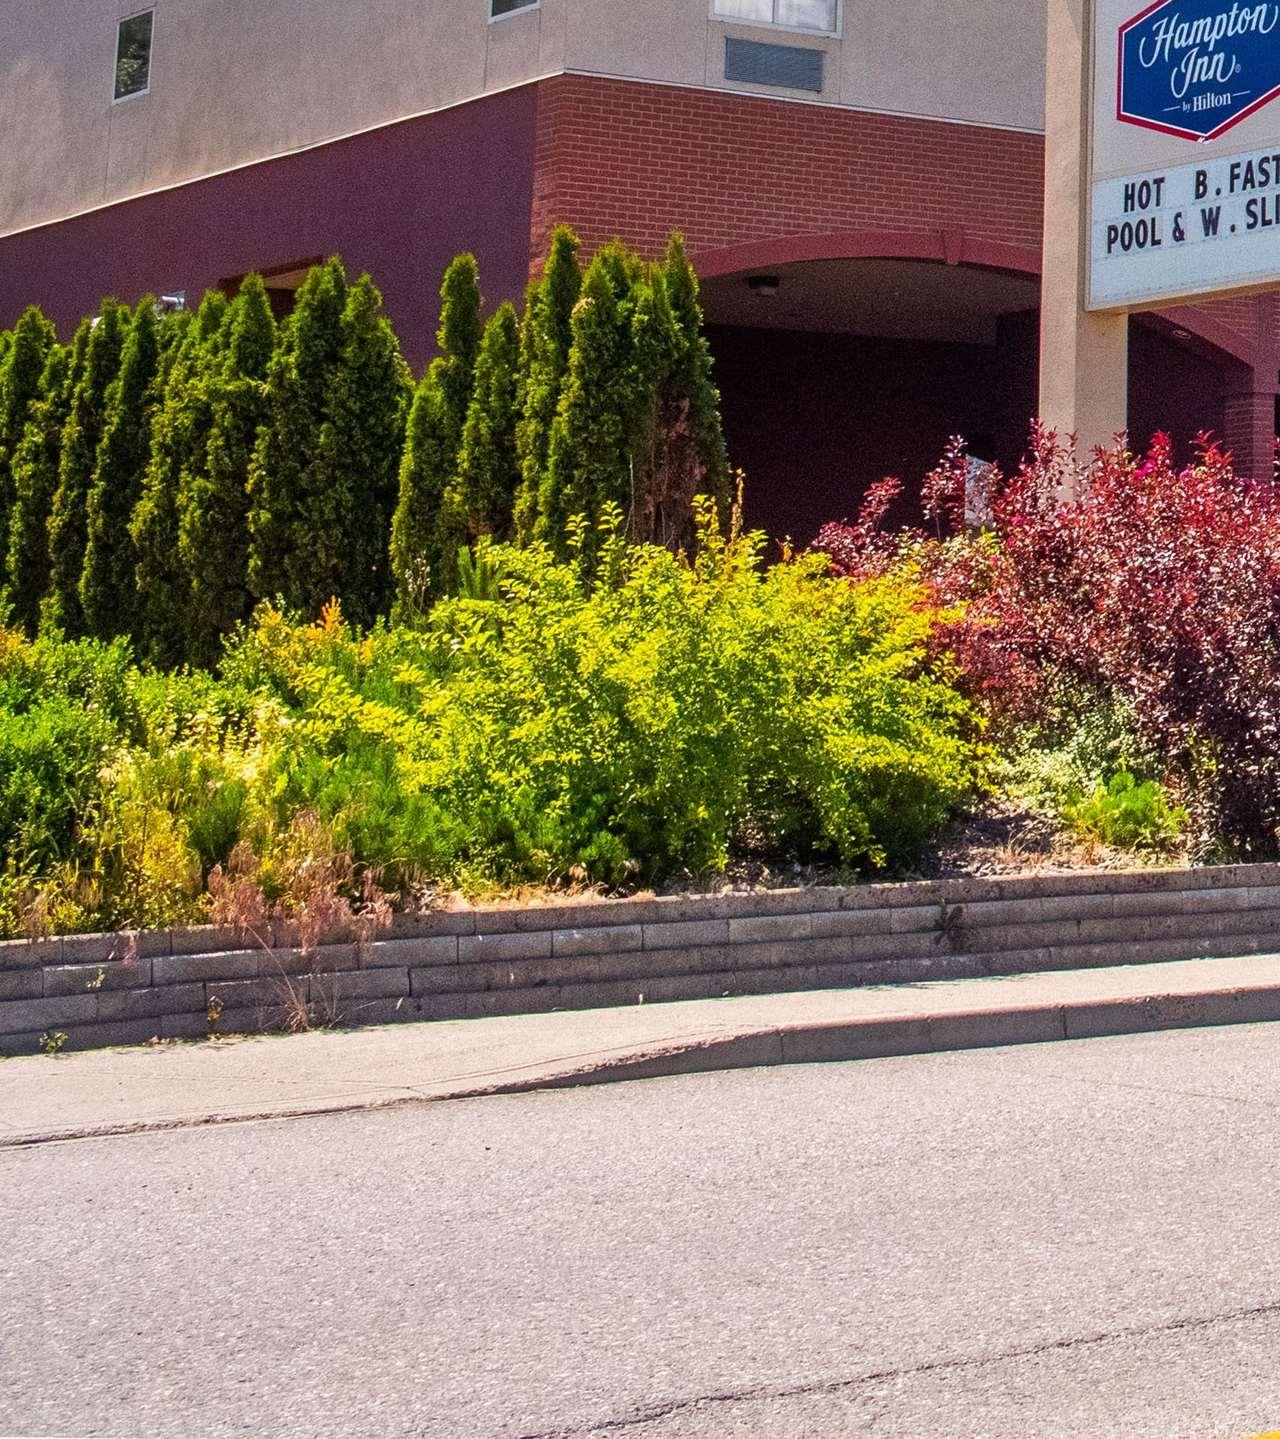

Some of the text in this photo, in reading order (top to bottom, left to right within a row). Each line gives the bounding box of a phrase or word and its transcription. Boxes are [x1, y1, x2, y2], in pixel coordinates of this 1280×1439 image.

[1139, 2, 1279, 68] Hampton
[1170, 46, 1236, 98] Inn
[1182, 92, 1232, 113] by Hilton
[1123, 177, 1165, 213] HOT
[1107, 216, 1162, 254] POOL
[1172, 211, 1185, 242] &
